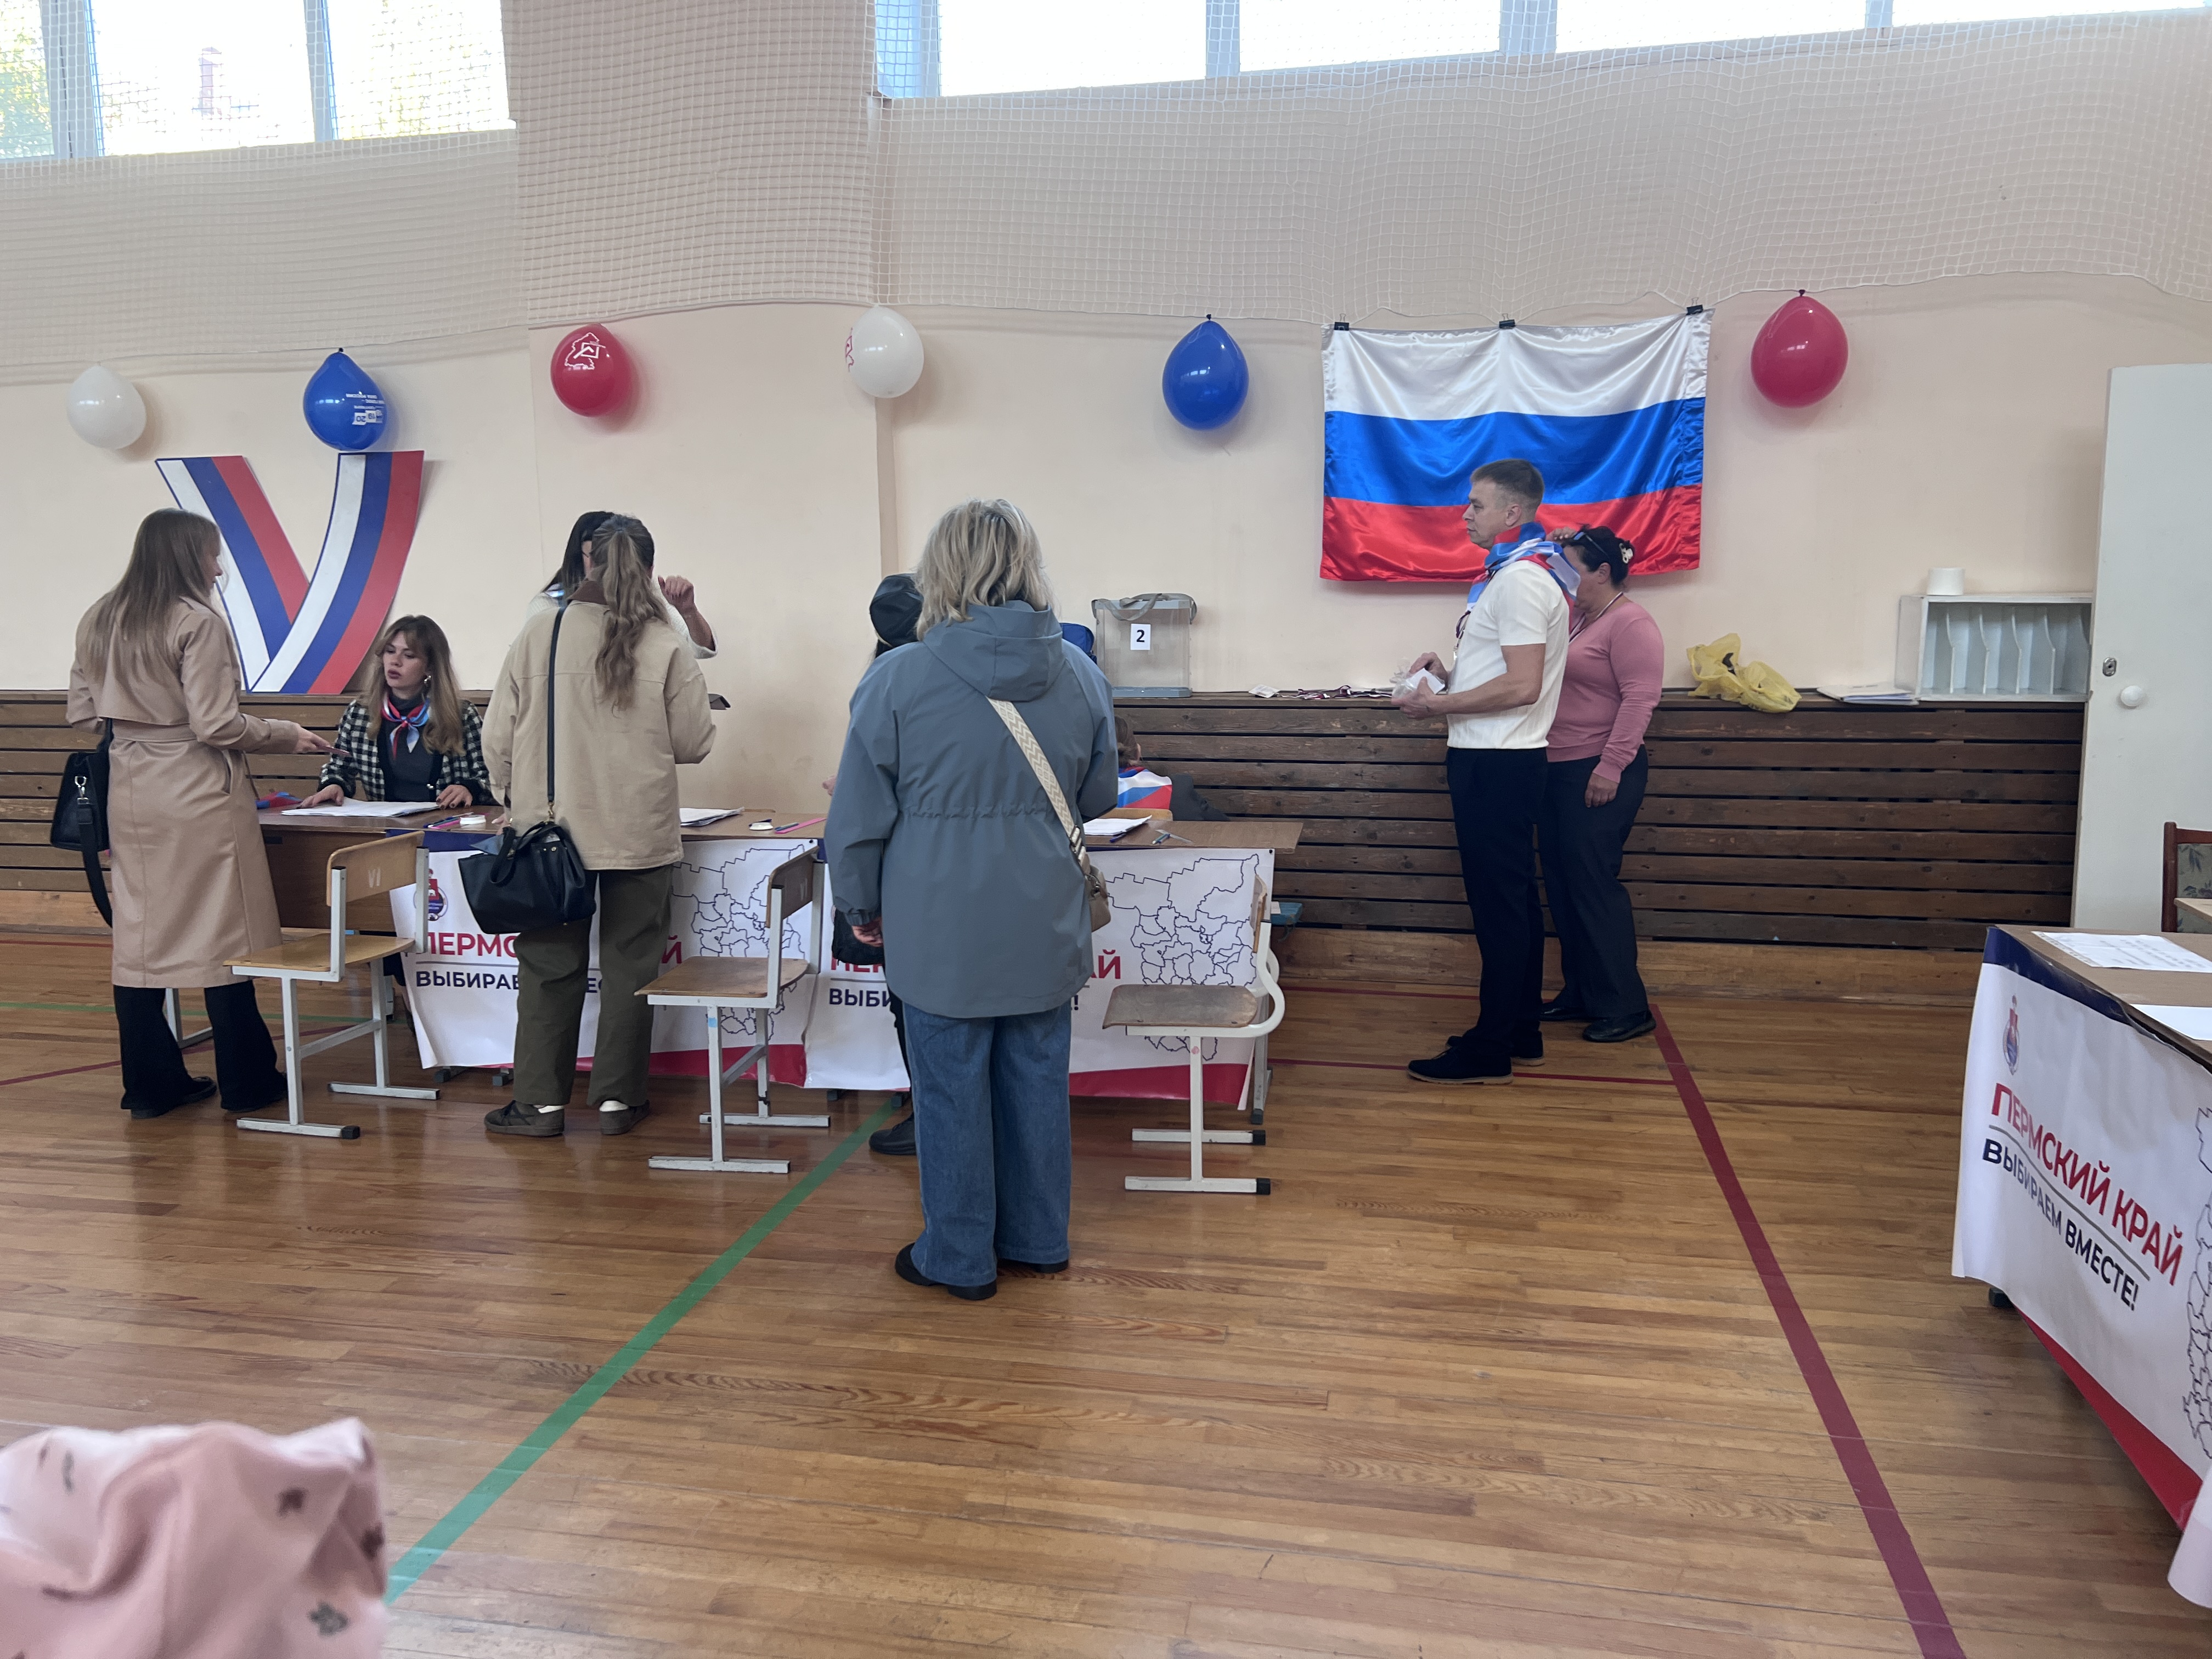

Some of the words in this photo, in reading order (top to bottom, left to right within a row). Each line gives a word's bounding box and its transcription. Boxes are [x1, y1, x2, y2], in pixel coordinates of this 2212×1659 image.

[1136, 629, 1146, 643] 2
[416, 970, 519, 990] ВЫБИРАЕ
[829, 988, 891, 1007] ВЫБИ
[1991, 1082, 2111, 1216] ПЕРМСКИЙ
[2112, 1188, 2183, 1286] КРАЙ
[1982, 1138, 2062, 1235] ВЫБИРАЕМ
[2065, 1218, 2139, 1311] ВМЕСТЕ!
